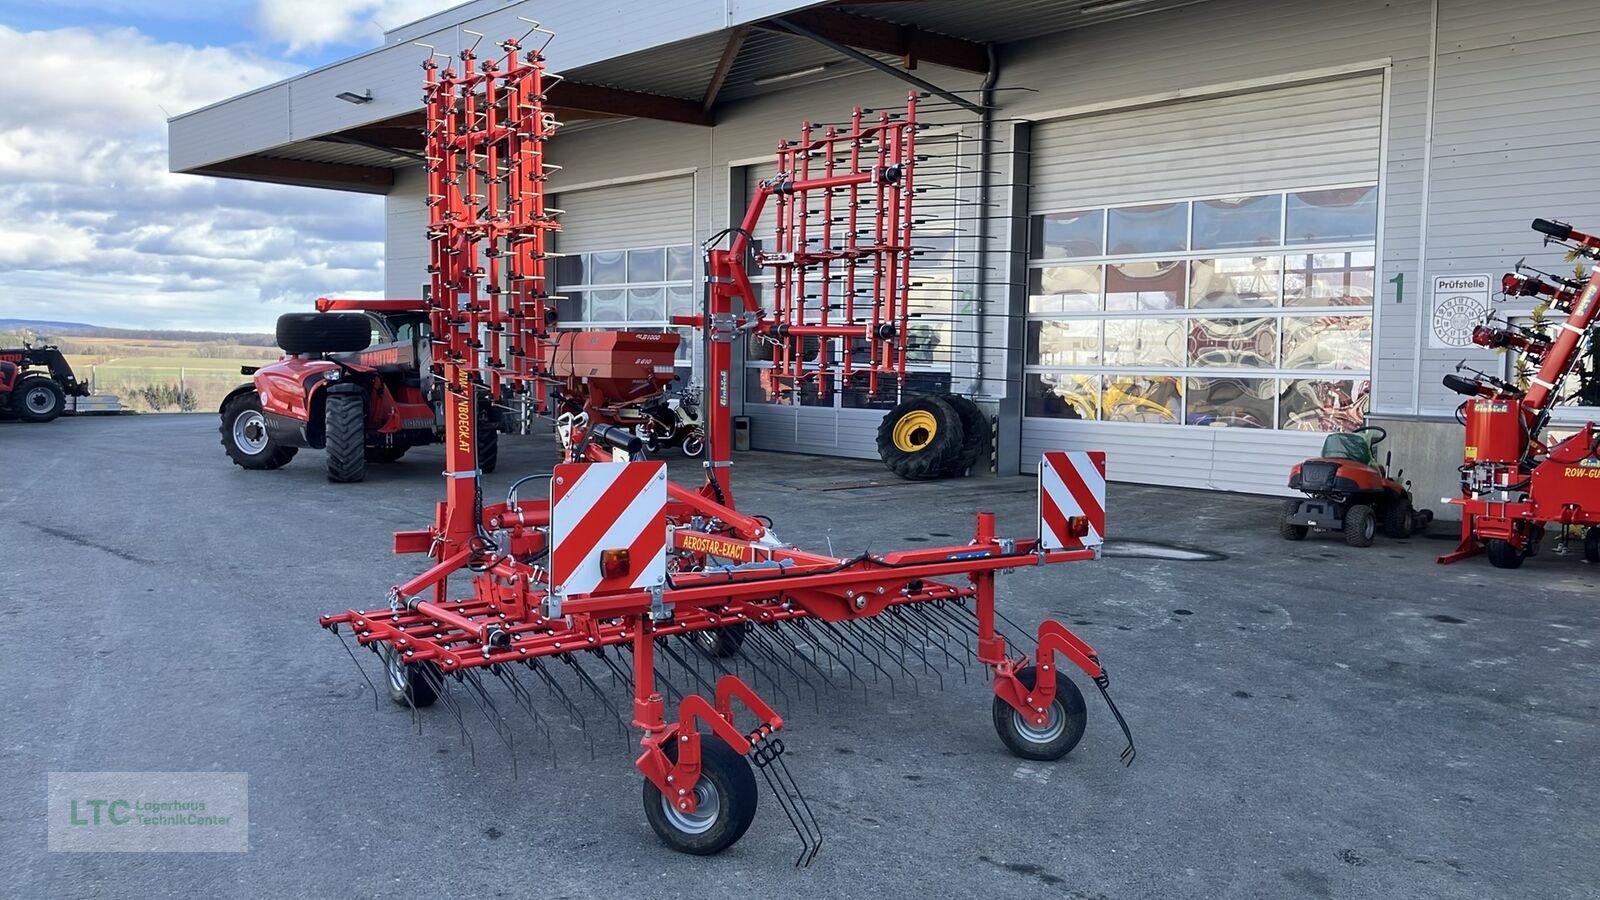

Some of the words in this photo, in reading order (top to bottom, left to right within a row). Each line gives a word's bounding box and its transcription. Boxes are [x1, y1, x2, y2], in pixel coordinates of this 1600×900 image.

[1389, 272, 1404, 304] 1
[1439, 279, 1485, 289] Prüfstelle
[682, 535, 745, 560] AEROSTAR-EXACT
